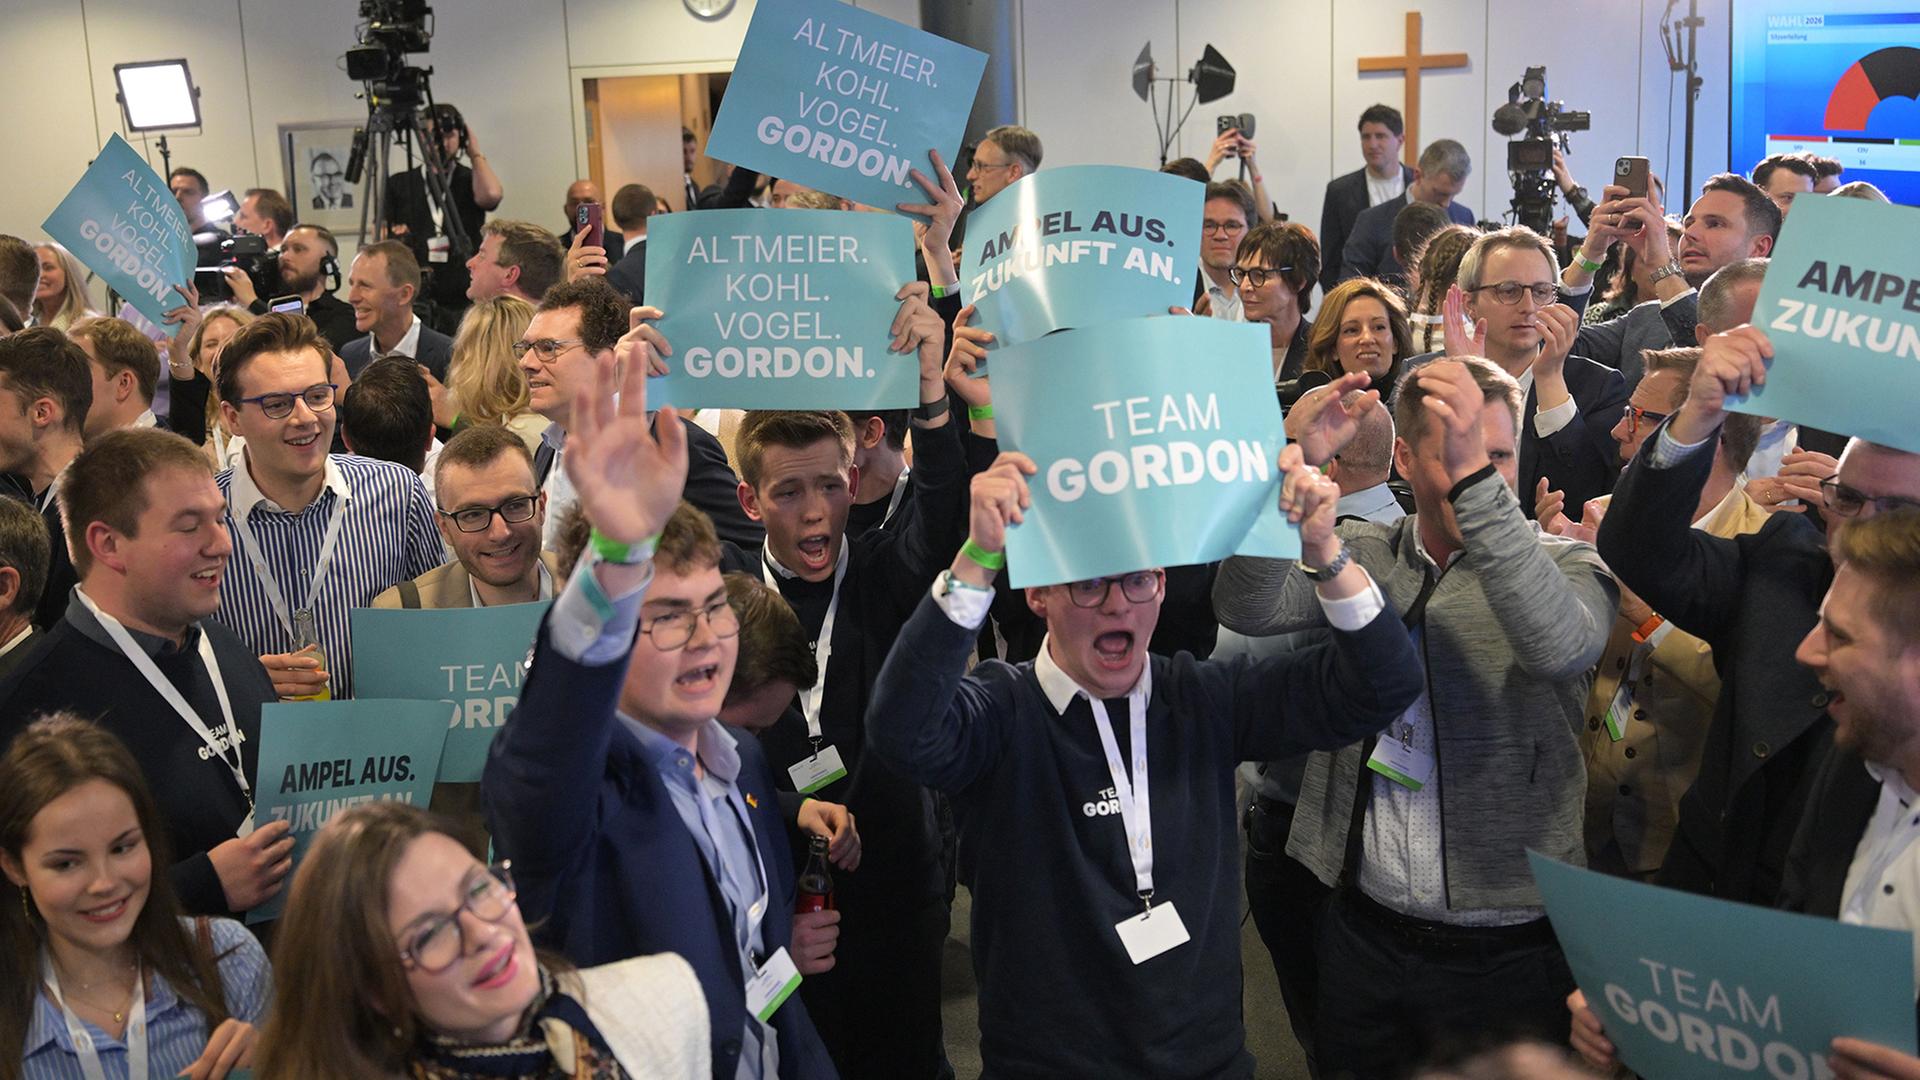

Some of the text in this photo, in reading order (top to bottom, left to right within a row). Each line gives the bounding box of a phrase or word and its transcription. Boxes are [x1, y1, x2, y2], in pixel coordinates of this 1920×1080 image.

[1805, 16, 1822, 25] 2026
[793, 18, 938, 88] ALTMEIER.
[815, 61, 899, 112] KOHL.
[799, 91, 897, 149] VOGEL.
[757, 116, 913, 189] GORDON.
[121, 168, 189, 253] ALTMEIER.
[127, 200, 173, 253] KOHL.
[1090, 210, 1174, 248] AUS.
[79, 219, 172, 307] GORDON.
[111, 213, 167, 276] VOGEL.
[687, 235, 868, 264] ALTMEIER.
[1123, 247, 1181, 285] AN.
[726, 273, 830, 302] KOHL.
[714, 311, 841, 340] VOGEL.
[684, 346, 876, 378] GORDON.
[1092, 392, 1221, 440] TEAM
[1046, 439, 1269, 503] GORDON
[280, 755, 415, 794] AMPEL AUS.
[1639, 958, 1782, 1033] TEAM
